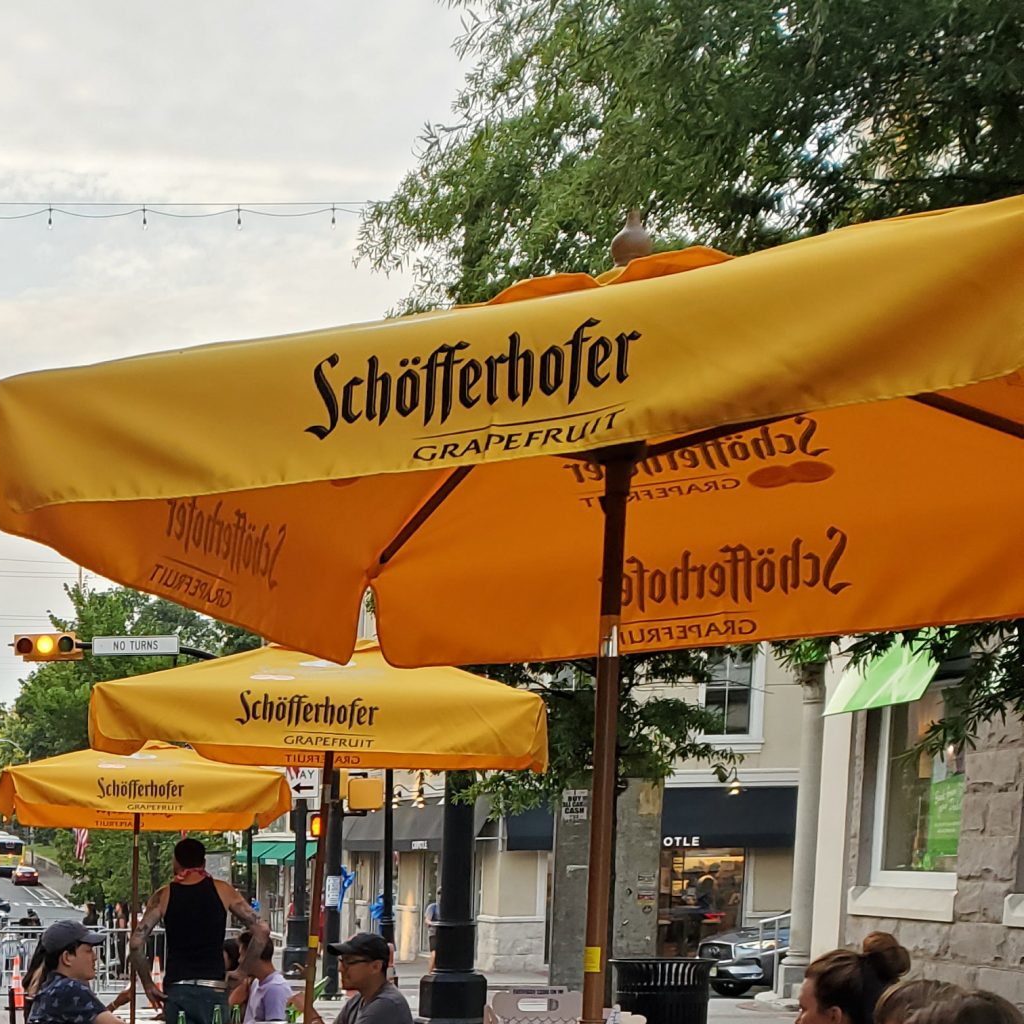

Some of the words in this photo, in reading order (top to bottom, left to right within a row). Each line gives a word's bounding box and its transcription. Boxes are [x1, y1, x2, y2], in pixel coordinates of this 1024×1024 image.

[304, 317, 642, 441] Schöfferhofer
[413, 408, 626, 462] GRAPEFRUIT
[113, 641, 125, 651] NO
[130, 640, 158, 651] TURNS
[235, 690, 379, 729] Schöfferhofer
[284, 735, 375, 748] GRAPEFRUIT
[294, 770, 315, 779] AY
[97, 777, 184, 799] Schöfferhofer
